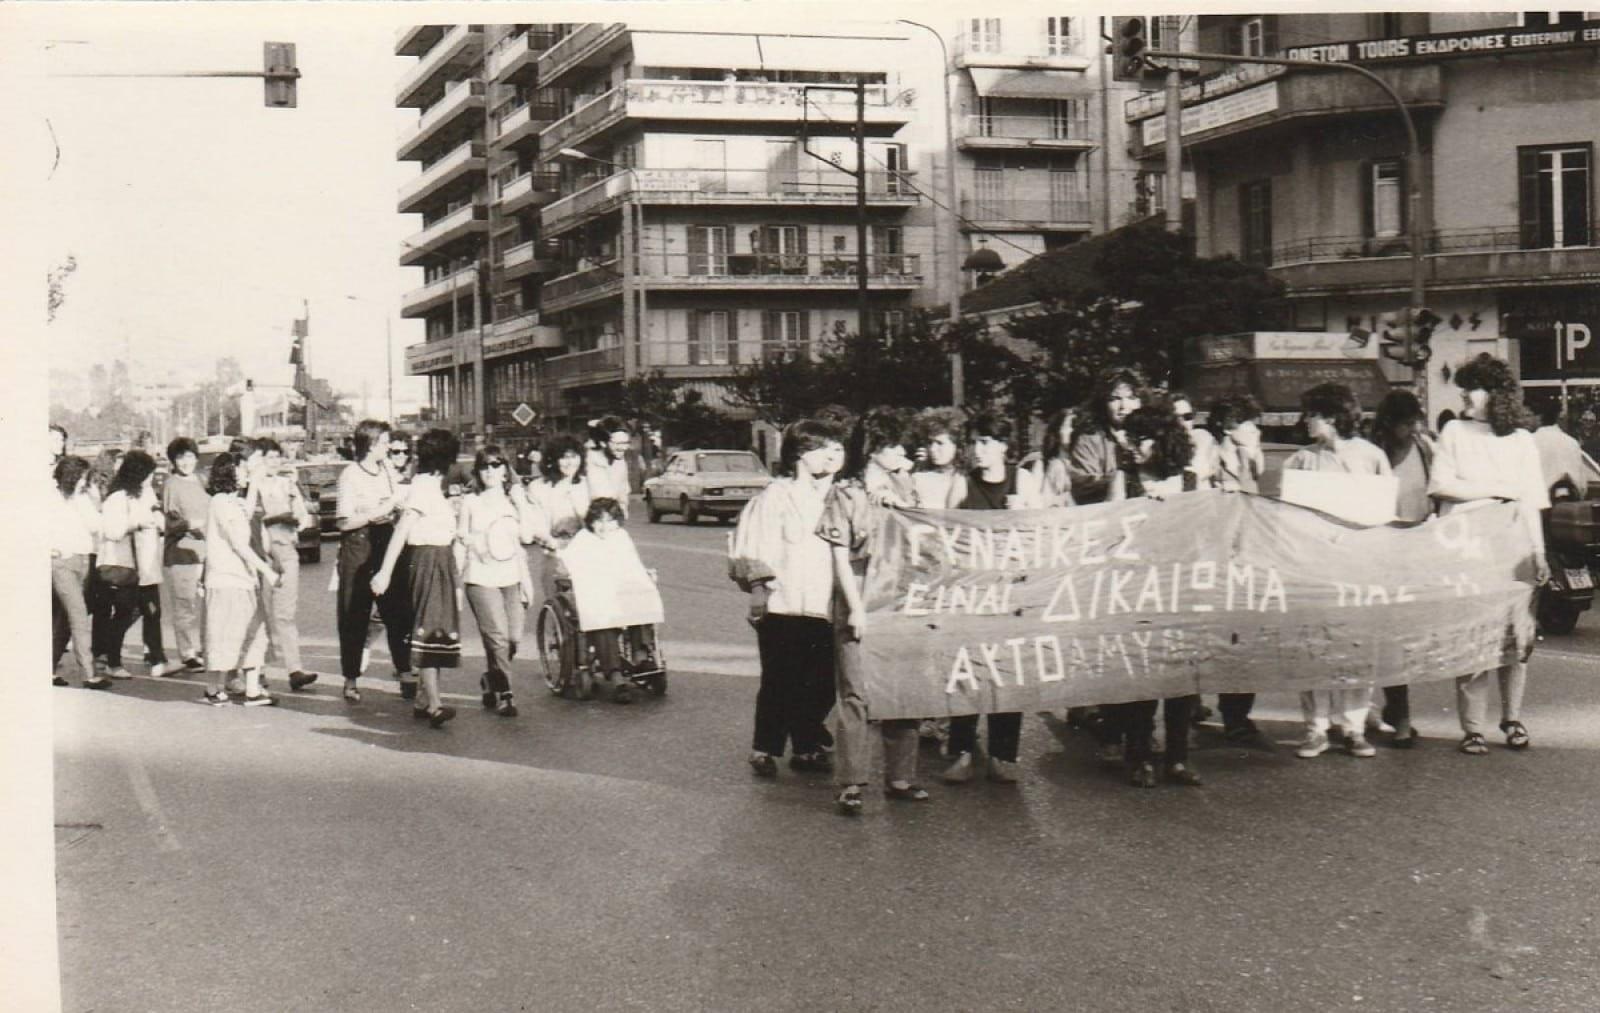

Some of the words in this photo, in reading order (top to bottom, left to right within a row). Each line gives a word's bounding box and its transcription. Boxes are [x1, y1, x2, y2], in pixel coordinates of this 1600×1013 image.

[1357, 38, 1409, 60] TOURS
[1415, 34, 1506, 55] ΕΚΔΡΟΜΕΣ
[1566, 322, 1592, 361] P
[908, 513, 1148, 571] ΓΥΝΑΙΚΕΣ
[904, 583, 1012, 616] ΕΙΝΑΙ
[1041, 560, 1287, 622] ΔΙΚΑΙΩΜΑ
